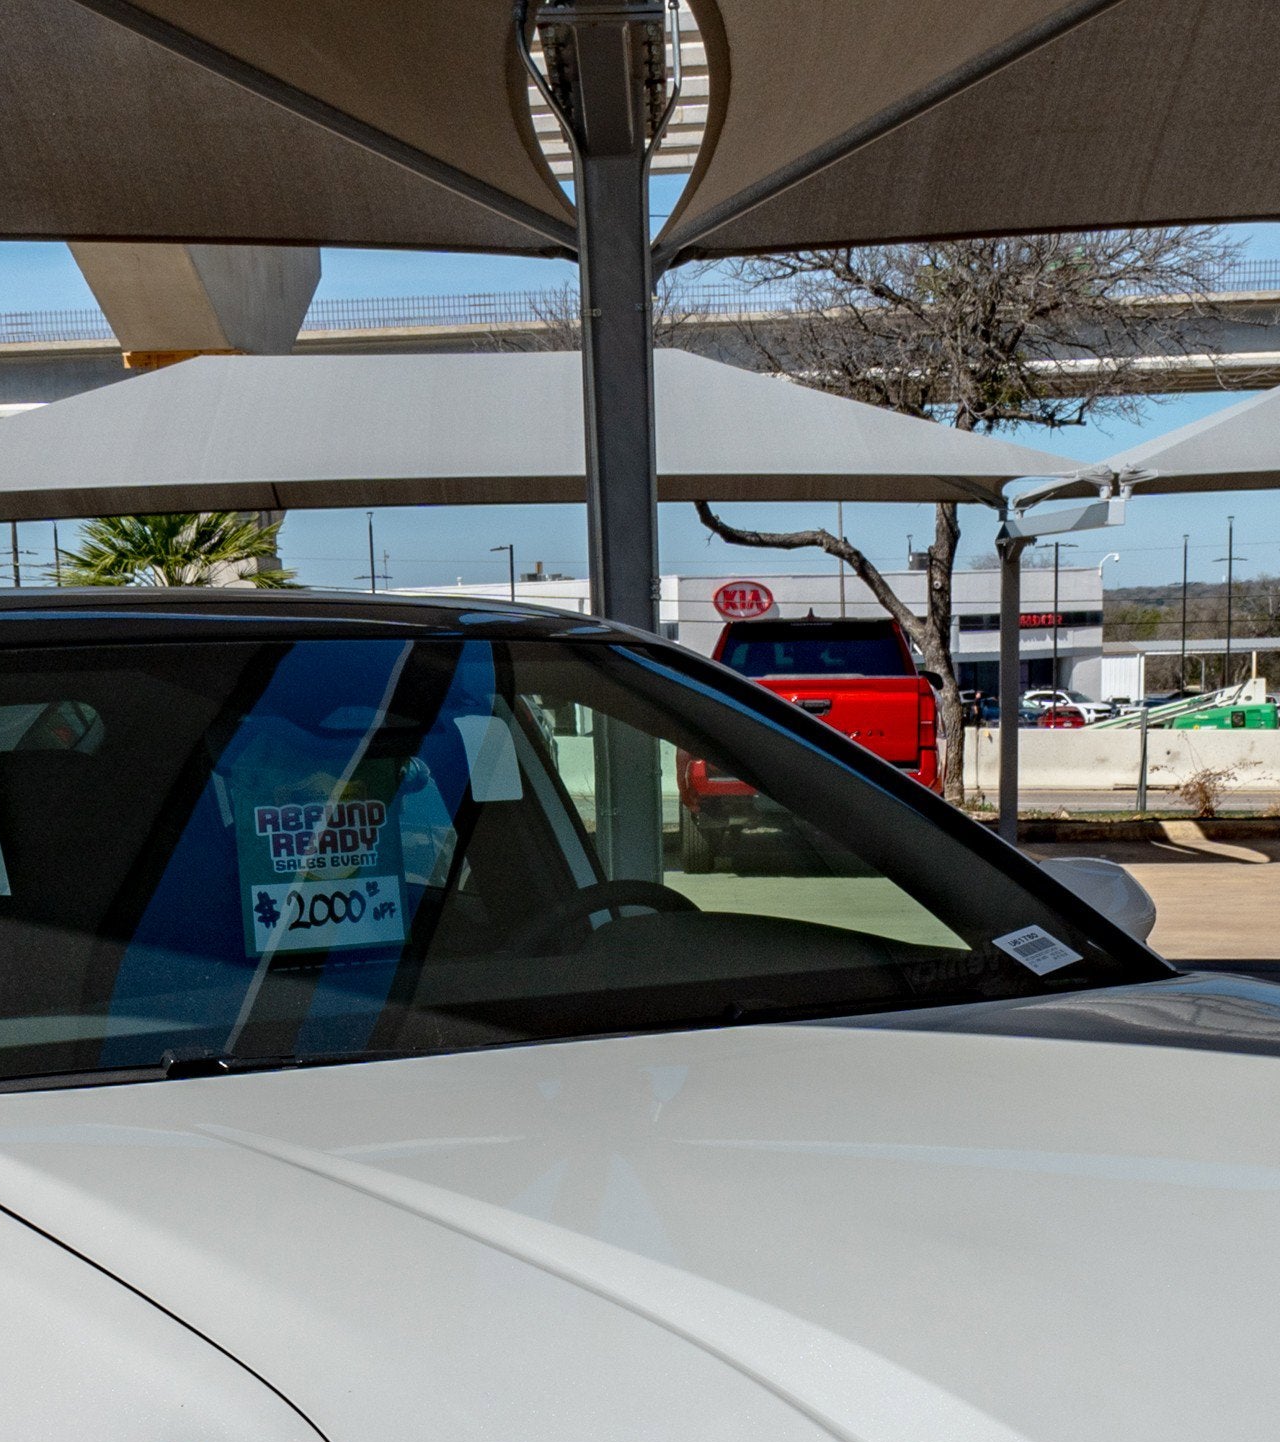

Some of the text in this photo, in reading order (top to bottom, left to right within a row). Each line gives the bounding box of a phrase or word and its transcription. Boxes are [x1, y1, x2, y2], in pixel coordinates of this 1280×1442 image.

[722, 589, 763, 610] KIA
[256, 801, 386, 834] REFUND
[272, 828, 379, 858] READY
[275, 852, 378, 872] SALES EVENT
